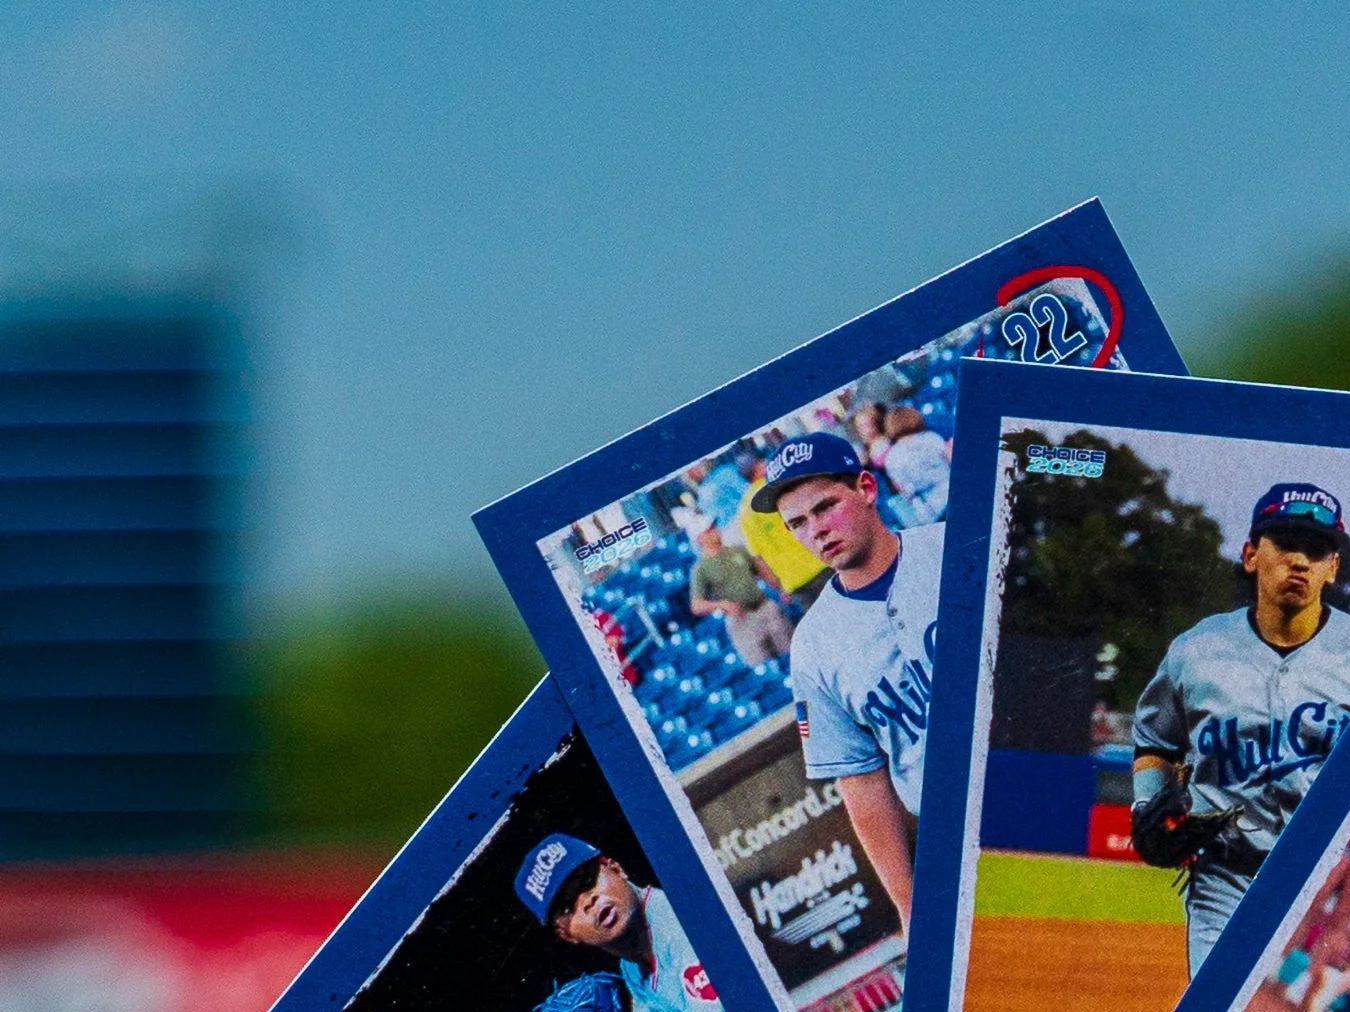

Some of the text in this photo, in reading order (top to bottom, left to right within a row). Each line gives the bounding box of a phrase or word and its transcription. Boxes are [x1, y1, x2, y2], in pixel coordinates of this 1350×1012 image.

[1002, 293, 1088, 365] 22
[1026, 444, 1106, 464] CHOICE
[1026, 456, 1105, 478] 2026
[574, 516, 649, 561] CHOICE
[583, 528, 652, 575] 2026
[1197, 716, 1285, 788] Hill
